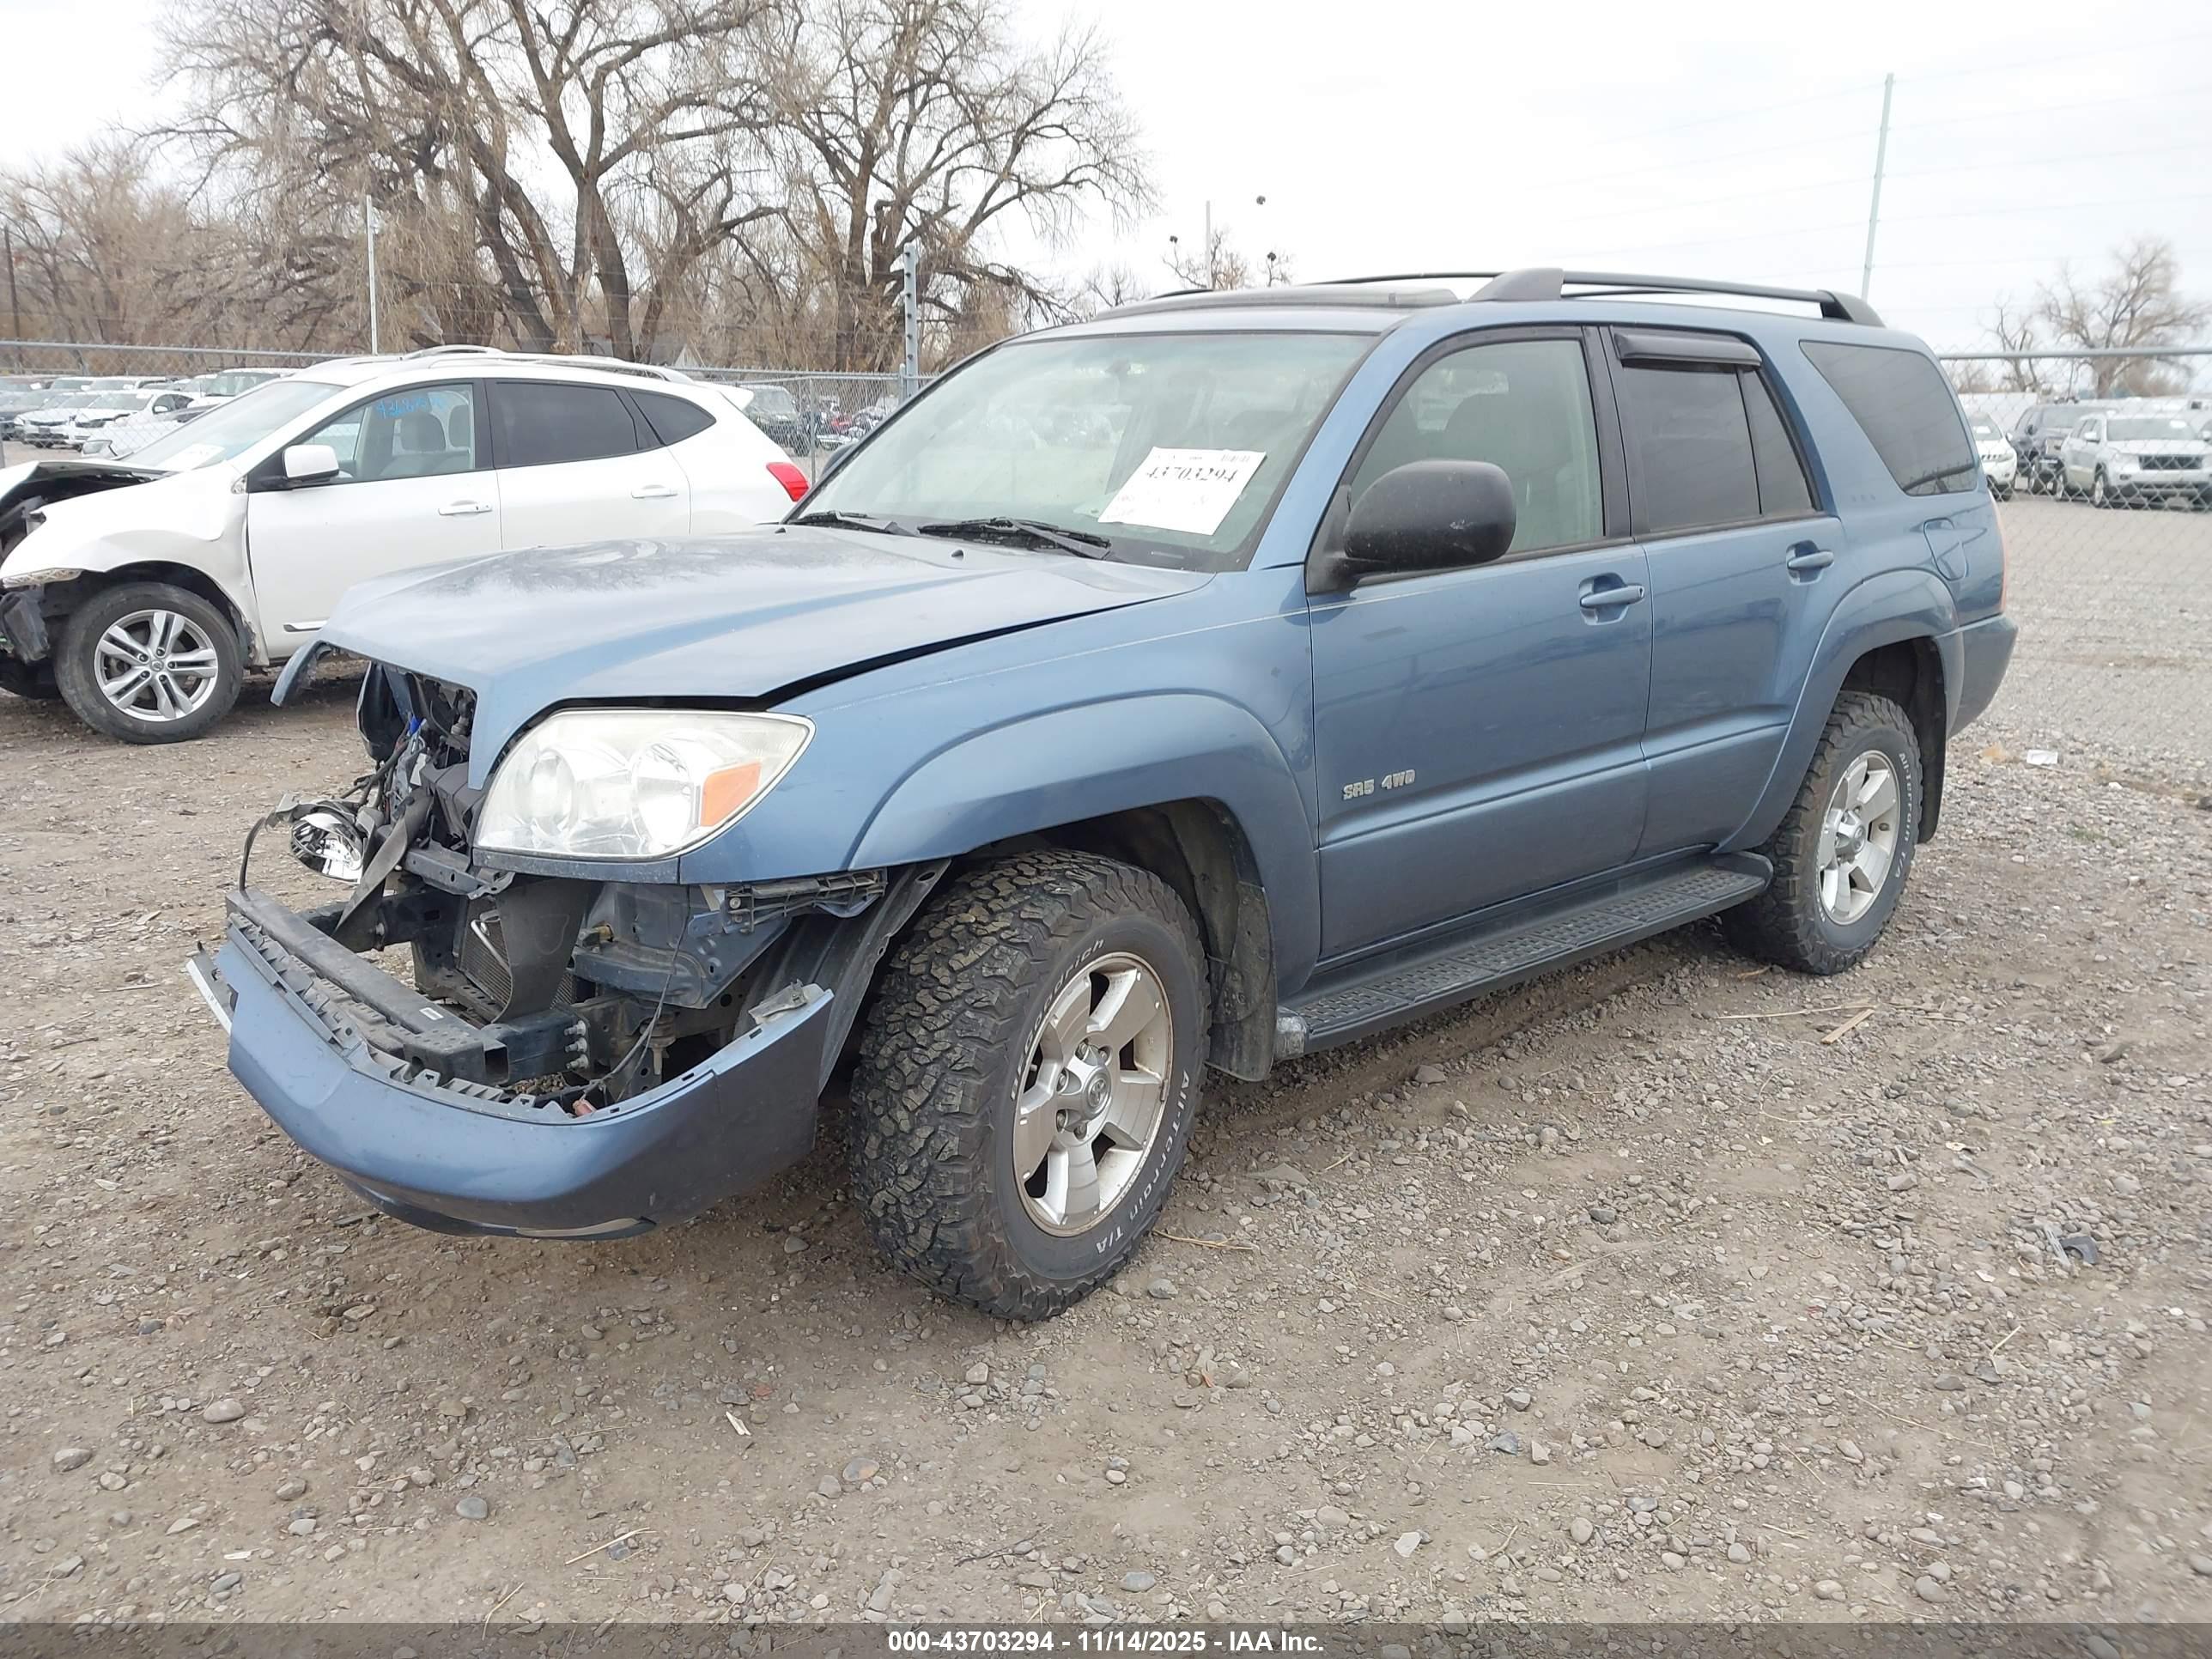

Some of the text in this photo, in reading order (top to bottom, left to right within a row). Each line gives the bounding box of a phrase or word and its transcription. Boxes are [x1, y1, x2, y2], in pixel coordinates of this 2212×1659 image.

[1343, 769, 1415, 800] SR5 4WD
[1096, 1070, 1189, 1255] All-Terrain T/A
